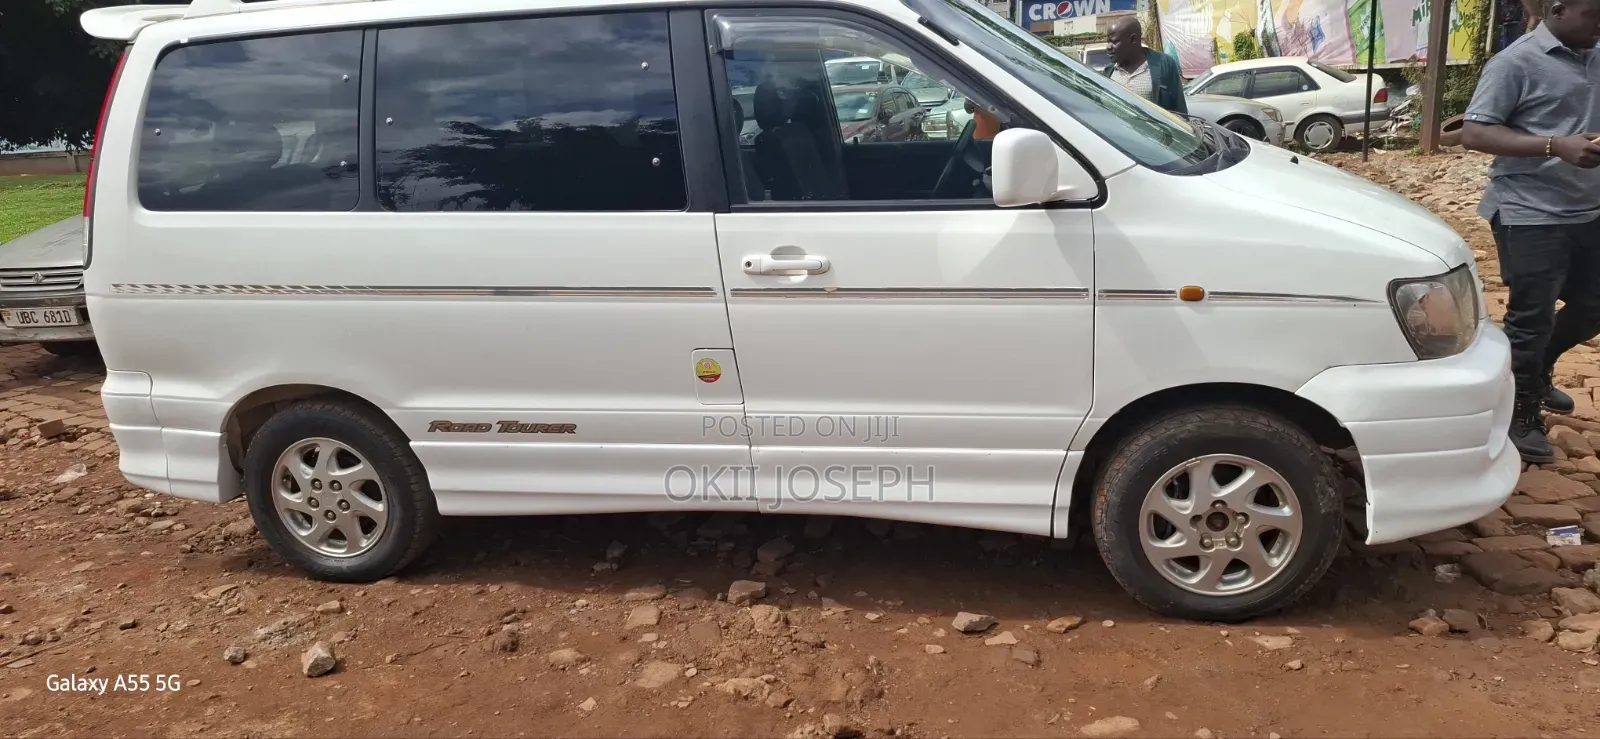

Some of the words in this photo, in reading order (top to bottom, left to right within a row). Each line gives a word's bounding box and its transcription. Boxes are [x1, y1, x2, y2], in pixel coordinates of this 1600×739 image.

[1028, 0, 1110, 21] CROWN
[16, 311, 39, 324] UBC
[43, 310, 72, 324] 681D
